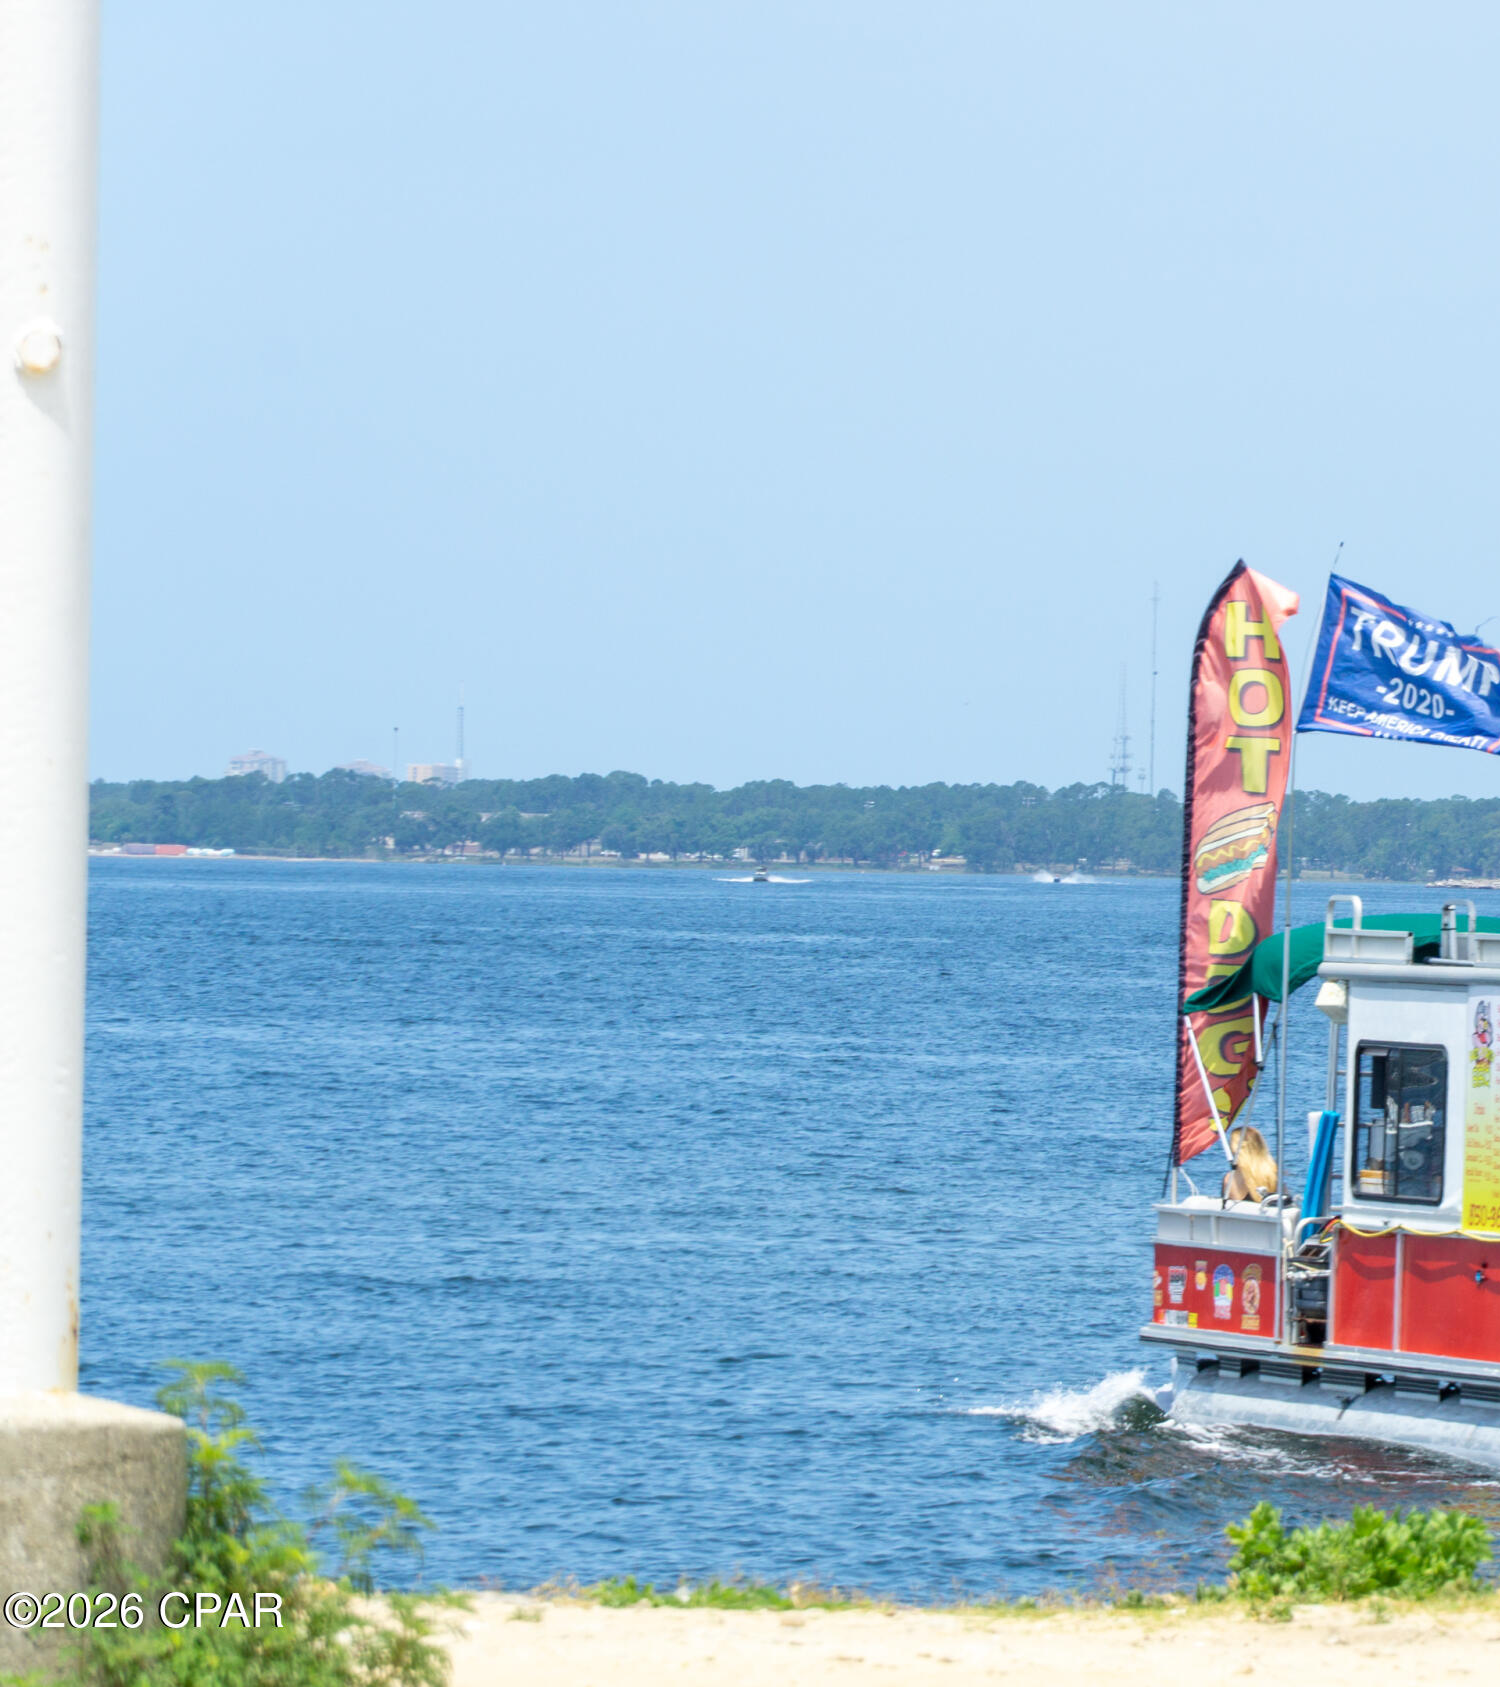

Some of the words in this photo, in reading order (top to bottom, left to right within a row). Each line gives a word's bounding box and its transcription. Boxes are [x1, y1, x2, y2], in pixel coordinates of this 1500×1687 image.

[1223, 600, 1285, 795] HOT
[1327, 696, 1366, 718] KEEP
[1363, 710, 1431, 737] AMERICA
